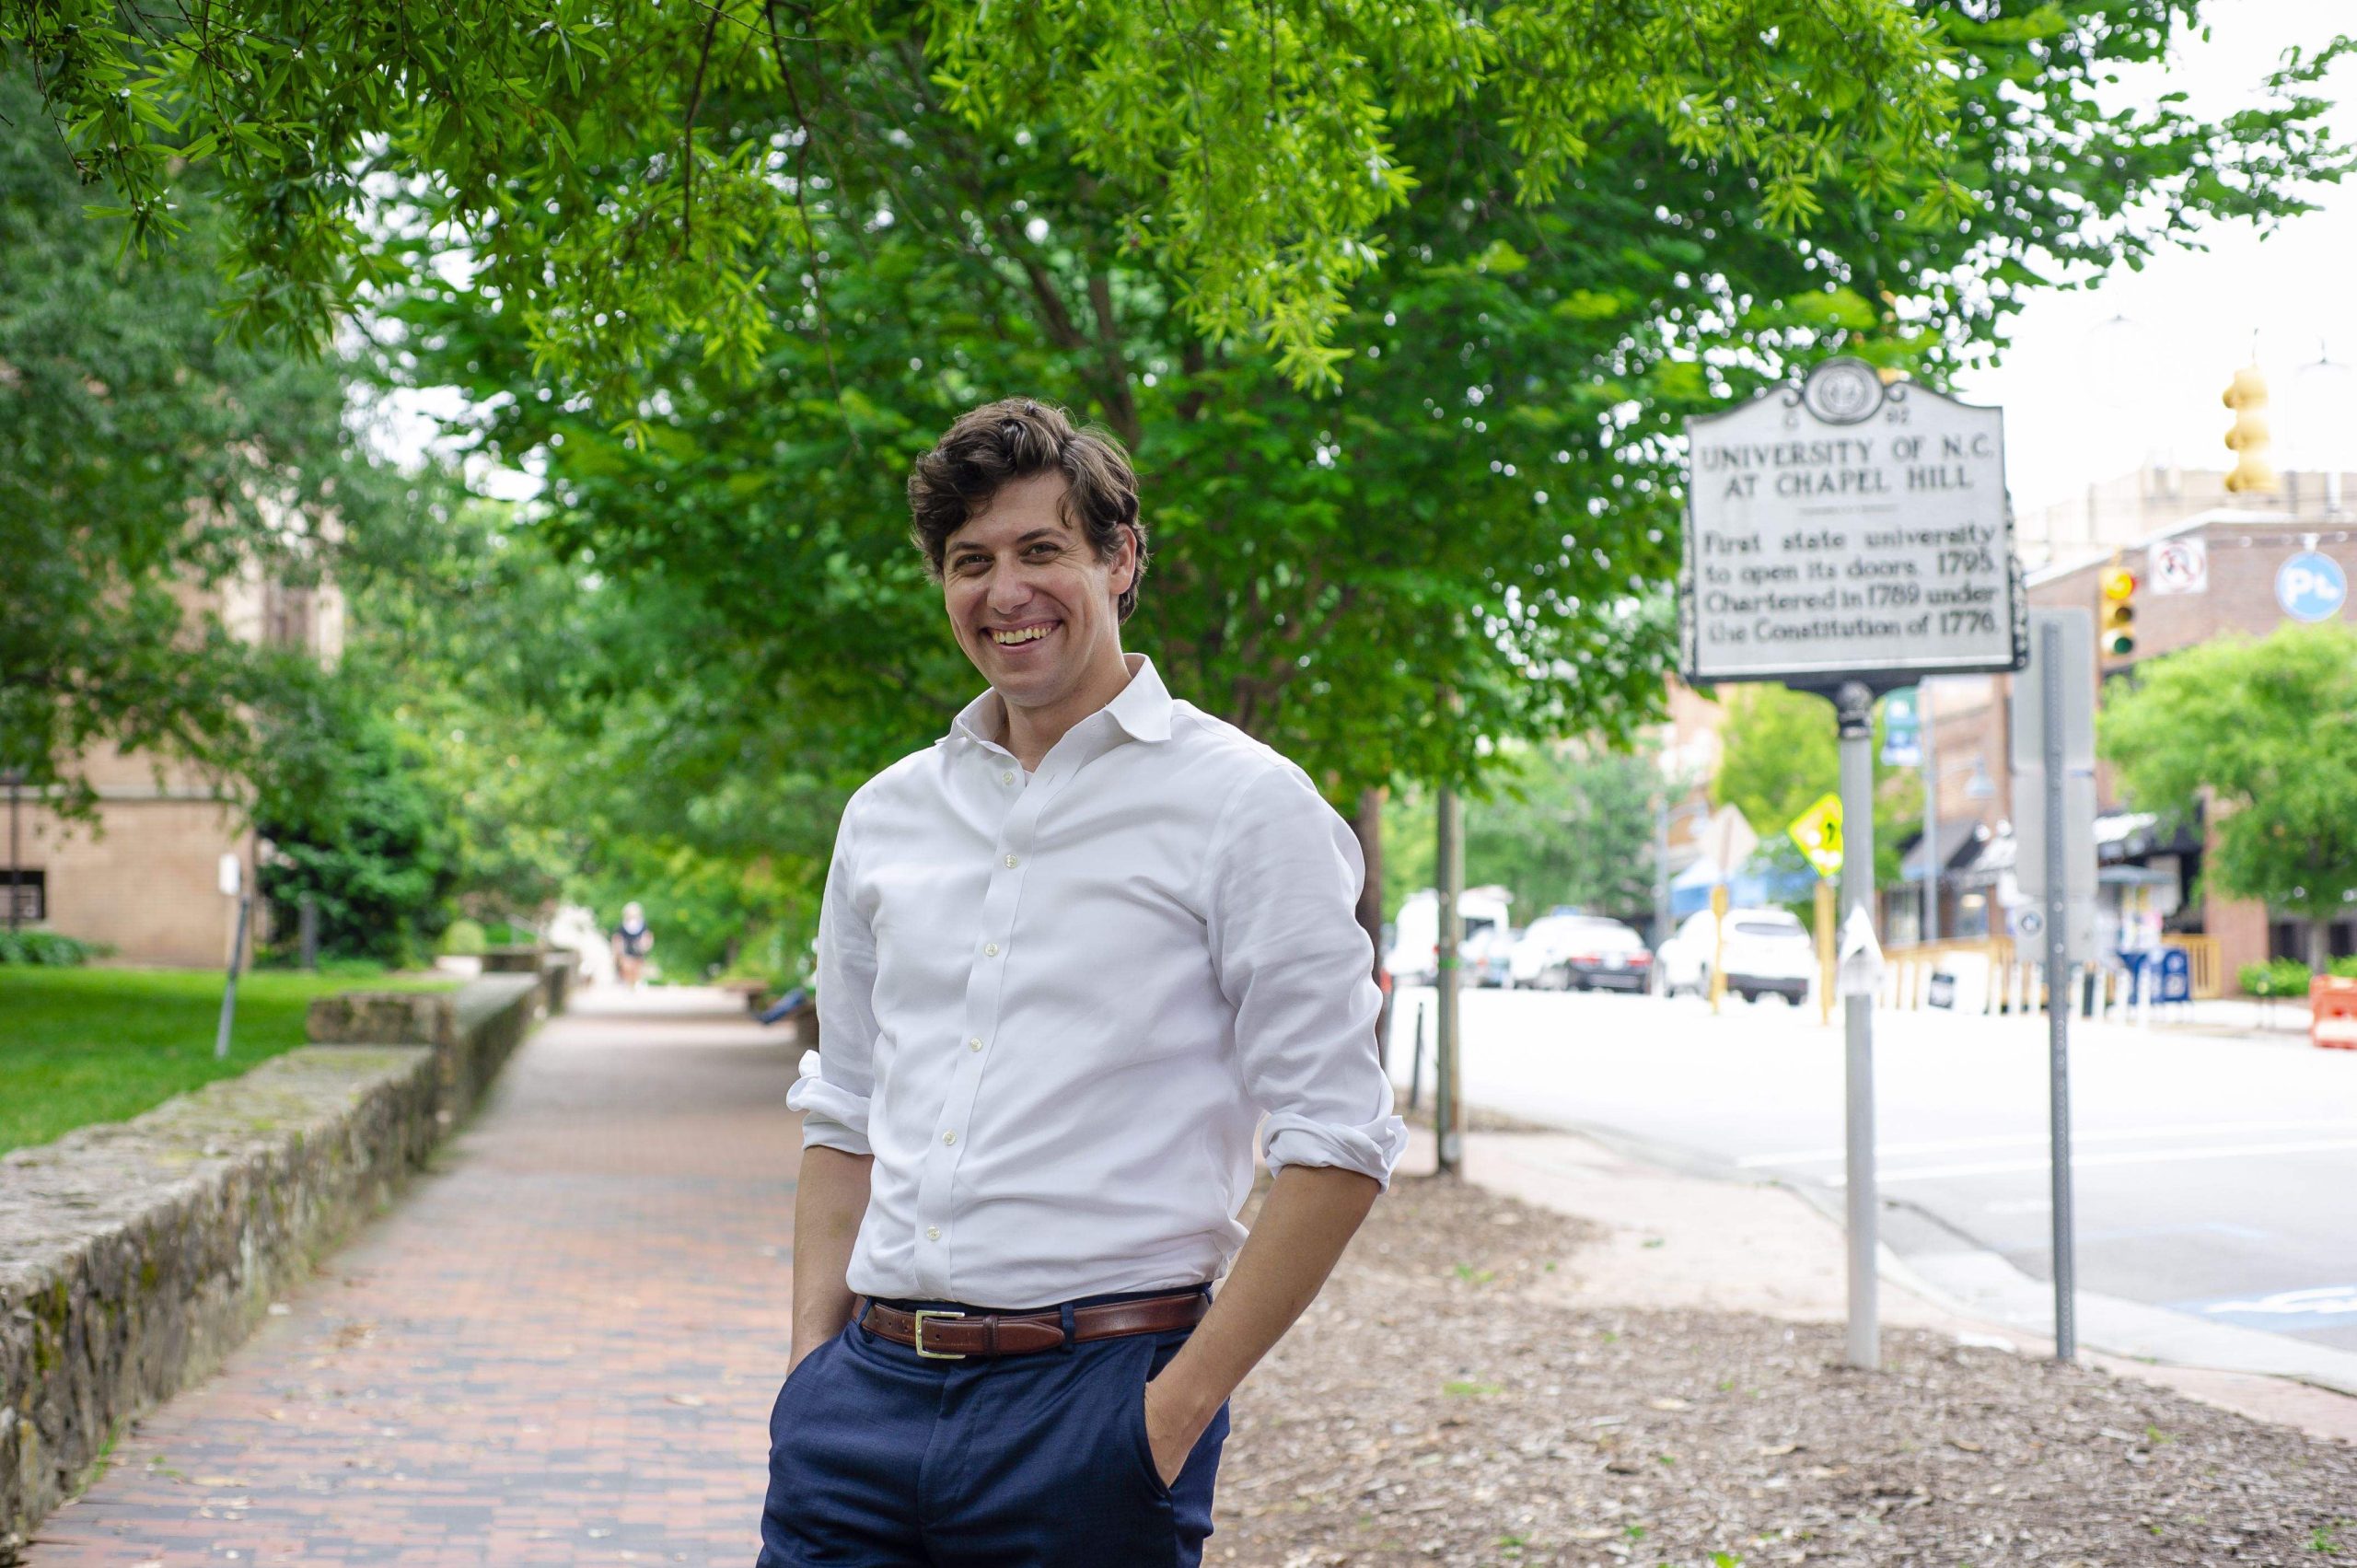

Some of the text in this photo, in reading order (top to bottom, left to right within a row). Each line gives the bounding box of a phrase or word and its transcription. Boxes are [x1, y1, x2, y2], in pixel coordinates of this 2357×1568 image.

[1701, 437, 1873, 472] UNIVERSITY
[1891, 436, 1926, 461] OF
[1722, 465, 1974, 501] AT CHAPEL HILL
[1704, 520, 1996, 555] First state university
[1705, 563, 1731, 585] to
[1739, 563, 1798, 587] open
[1807, 560, 1837, 580] its
[1704, 580, 1999, 614] Chartered in 1789 under
[1708, 621, 1747, 645] the
[1754, 617, 1900, 644] Constitution
[1907, 612, 1933, 637] of
